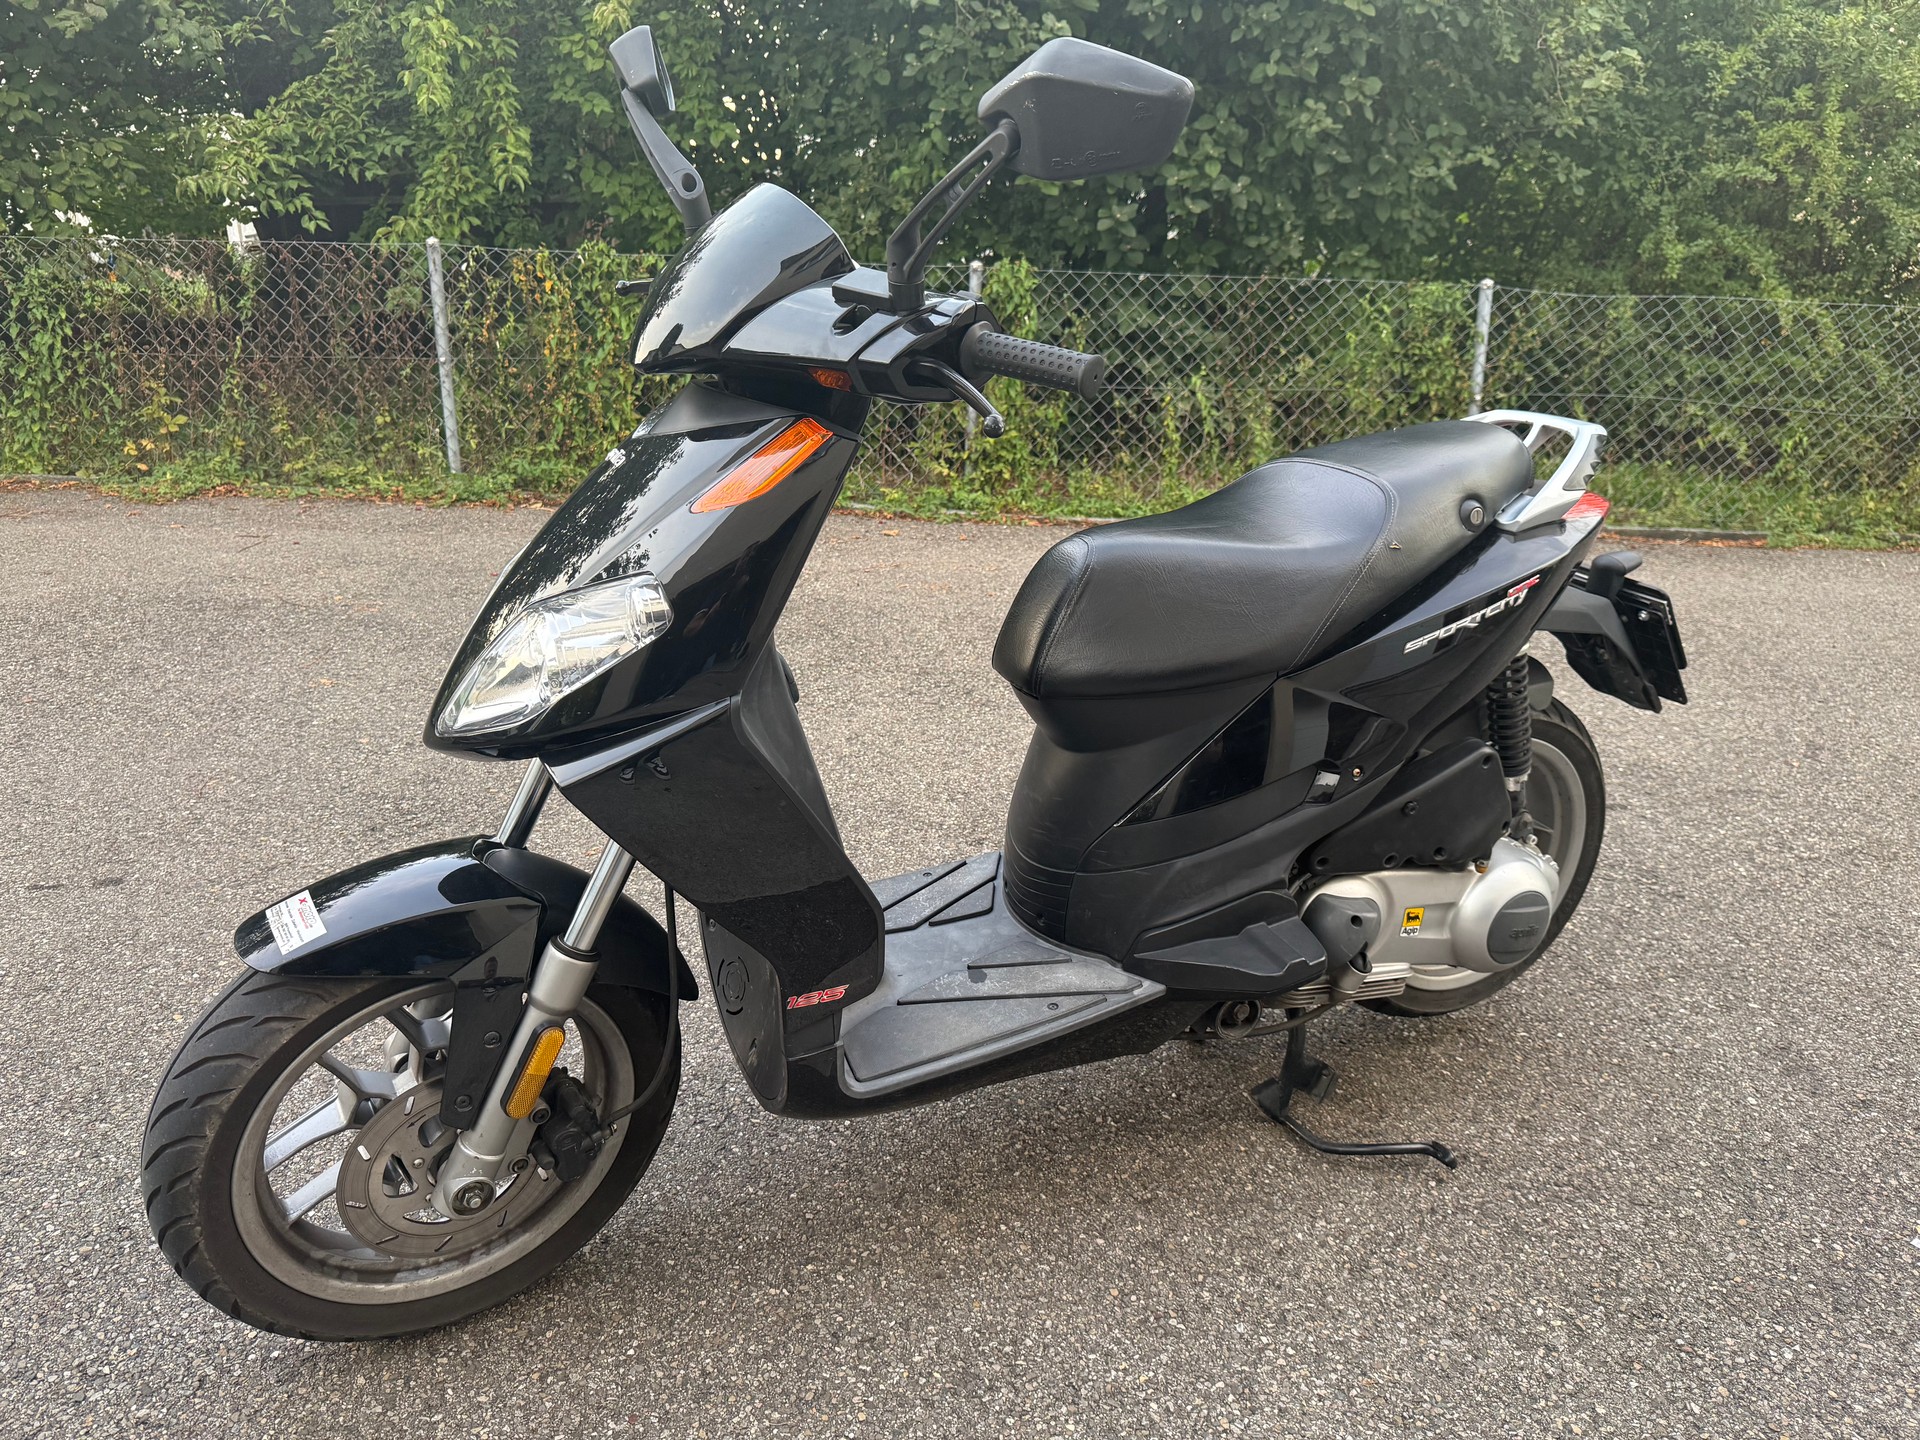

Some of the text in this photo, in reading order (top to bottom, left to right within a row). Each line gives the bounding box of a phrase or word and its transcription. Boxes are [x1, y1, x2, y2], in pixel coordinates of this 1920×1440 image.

[1403, 588, 1528, 655] SPORTCITY
[1401, 927, 1418, 936] Agip
[787, 984, 850, 1010] 125
